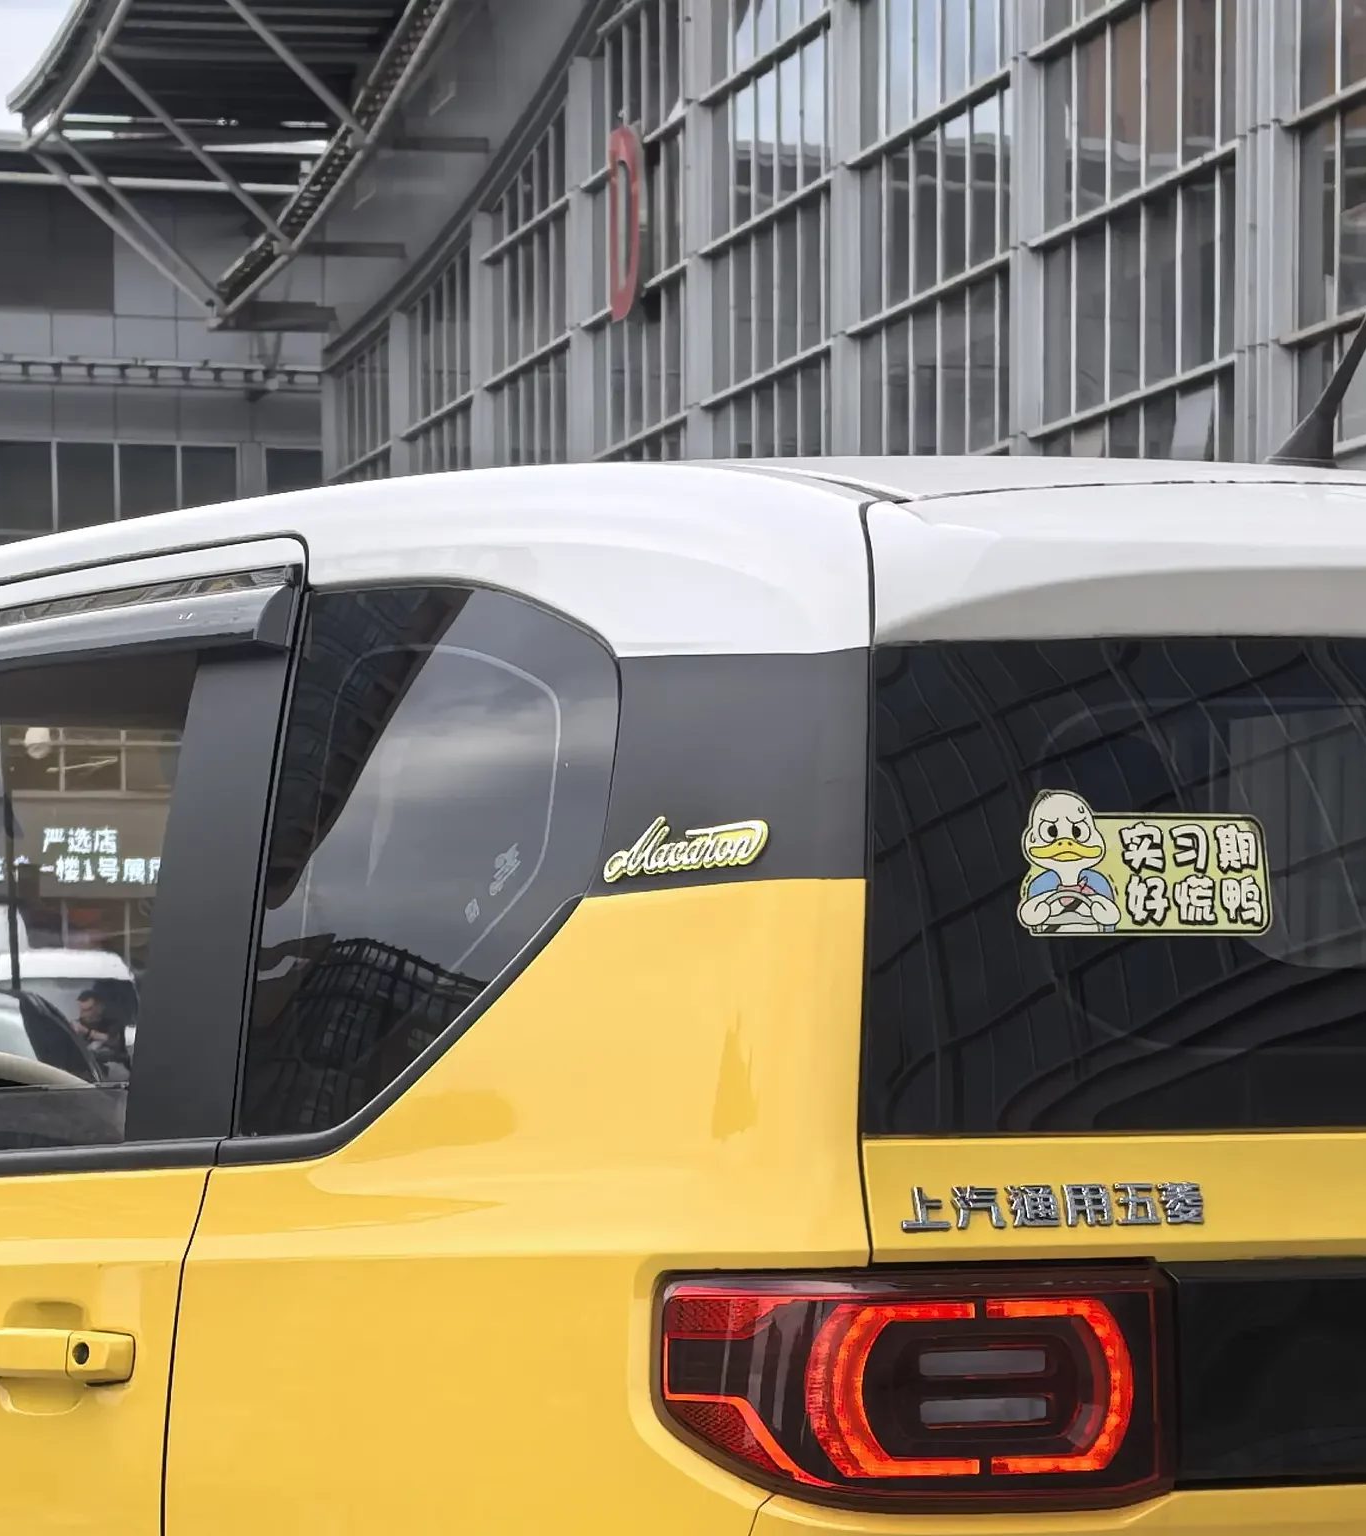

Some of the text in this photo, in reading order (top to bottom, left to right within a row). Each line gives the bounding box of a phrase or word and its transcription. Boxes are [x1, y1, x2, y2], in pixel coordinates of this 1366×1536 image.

[42, 826, 118, 853] 严选店
[603, 816, 769, 883] Macaron
[1119, 821, 1259, 873] 实习期
[1125, 873, 1264, 926] 好慌鸭
[901, 1181, 1204, 1232] 上汽通用五菱
